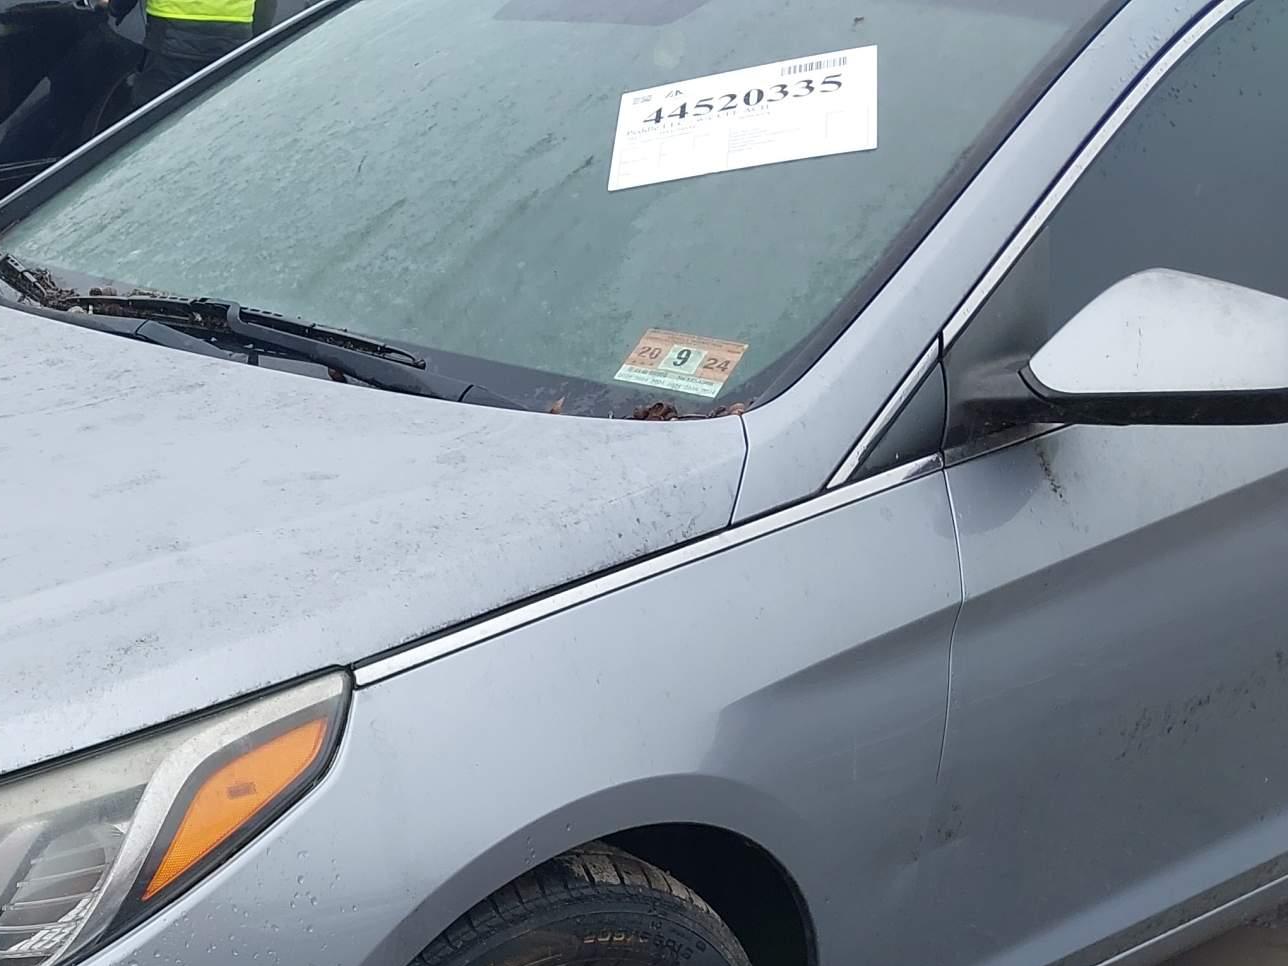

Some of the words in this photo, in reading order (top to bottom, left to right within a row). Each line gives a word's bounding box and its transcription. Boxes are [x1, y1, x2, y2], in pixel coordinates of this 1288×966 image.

[642, 73, 842, 124] 44520335
[638, 346, 661, 360] 20
[672, 349, 691, 367] 9
[703, 357, 730, 372] 24
